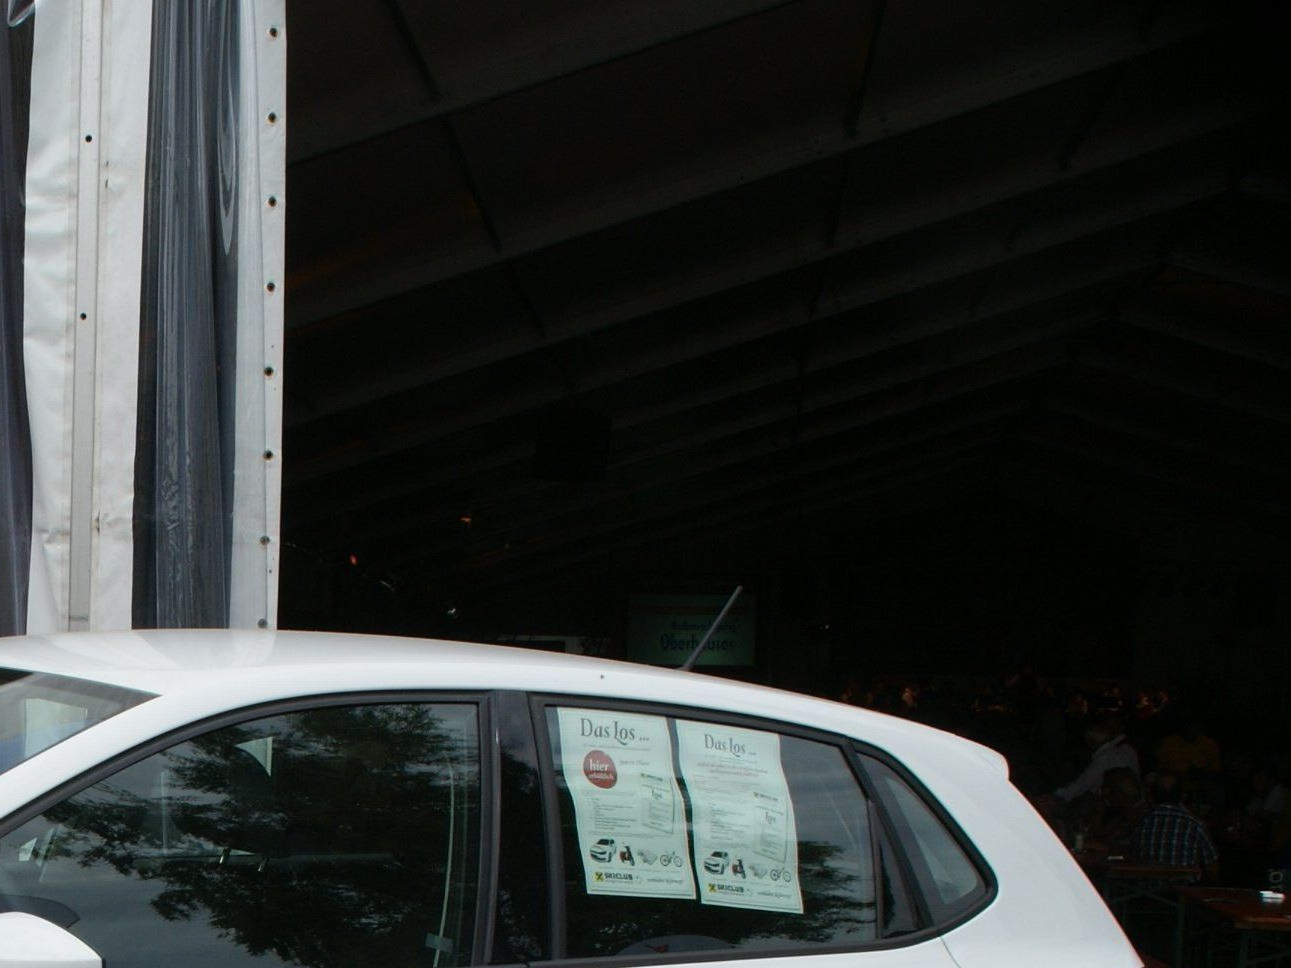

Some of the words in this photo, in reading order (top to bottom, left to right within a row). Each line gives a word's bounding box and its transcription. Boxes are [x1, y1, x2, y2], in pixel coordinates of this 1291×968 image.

[580, 717, 610, 738] Das
[612, 719, 636, 746] Los
[704, 732, 727, 752] Das
[728, 737, 747, 758] Los
[589, 757, 610, 773] hier
[604, 872, 634, 882] SKICLUB
[717, 884, 745, 893] SKICLUB
